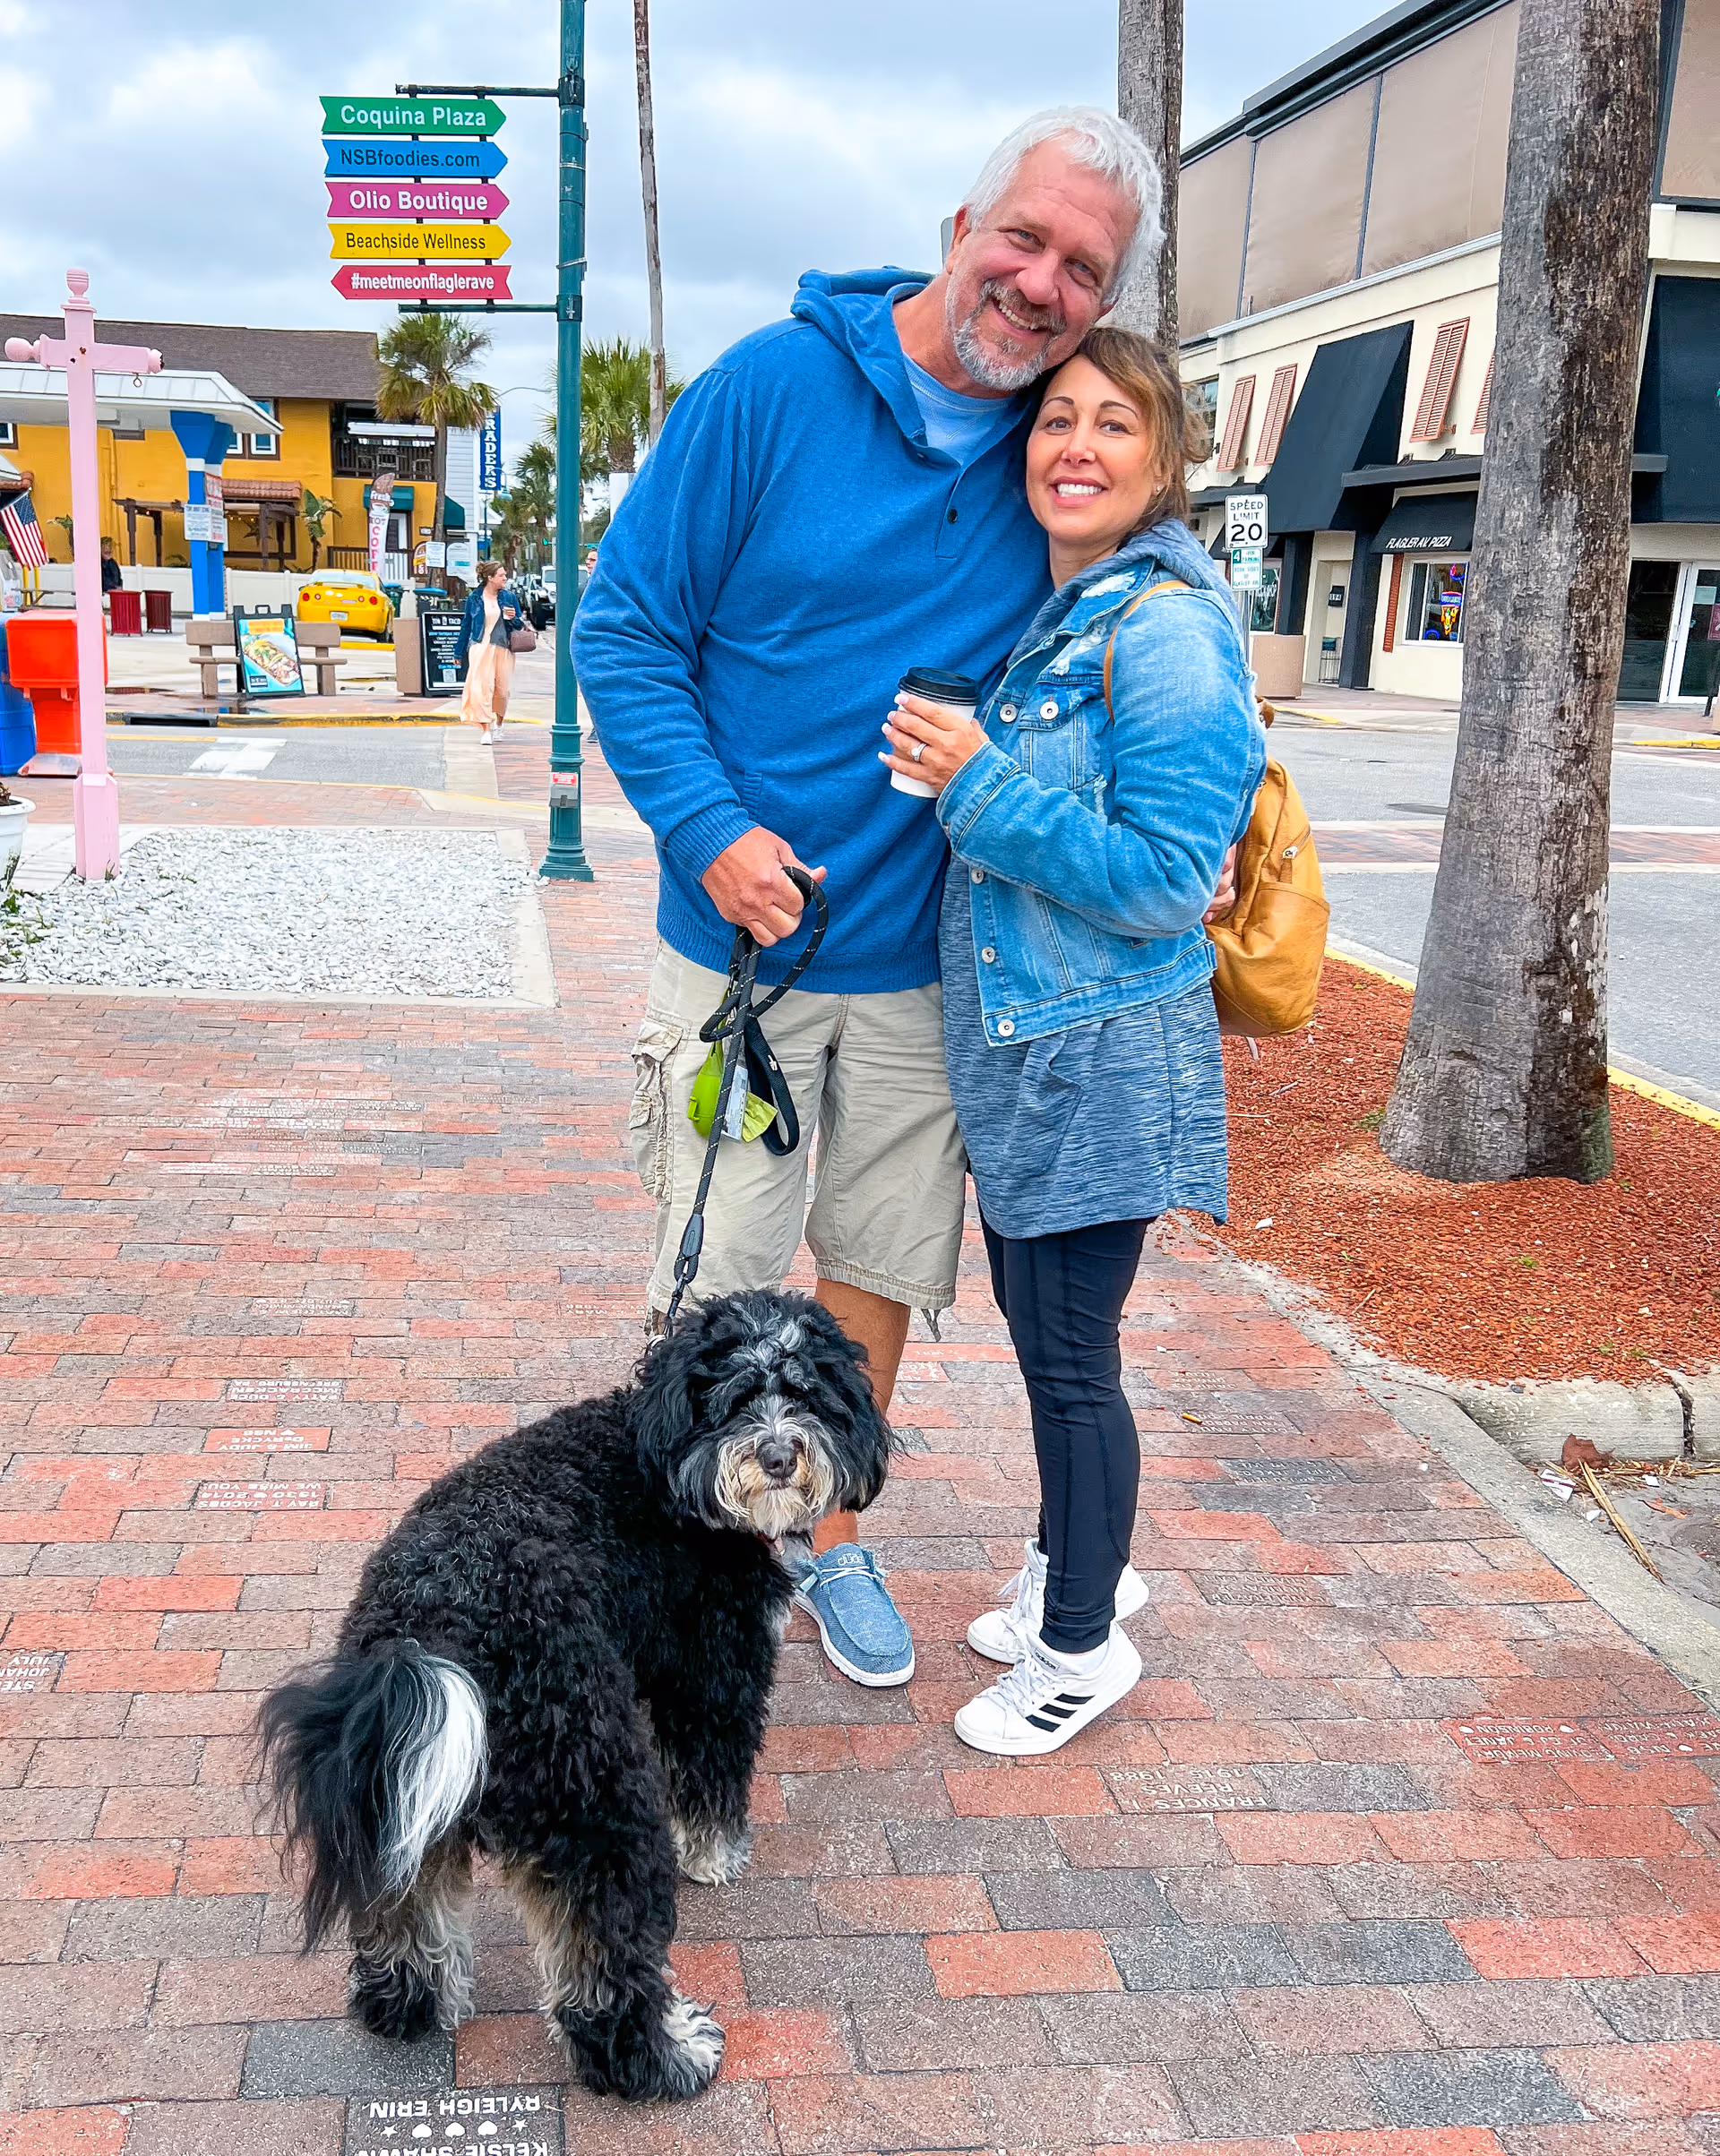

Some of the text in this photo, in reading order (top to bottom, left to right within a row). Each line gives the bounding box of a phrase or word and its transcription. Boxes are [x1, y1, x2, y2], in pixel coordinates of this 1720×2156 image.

[340, 105, 486, 129] Coquina Plaza
[340, 149, 480, 167] NSBfoodies.com
[349, 190, 488, 215] Olio Boutique
[346, 232, 486, 249] Beachside Wellness
[350, 272, 494, 293] #meetmeonflaglerave
[1230, 502, 1264, 511] SPEED
[1234, 512, 1260, 521] LIMIT
[1231, 523, 1262, 542] 20
[1386, 537, 1420, 548] FLAGLER
[1428, 537, 1452, 547] PIZZA
[1234, 549, 1241, 563] 4
[197, 1500, 262, 1508] JACOBS
[1035, 1652, 1056, 1670] adidas
[0, 1680, 36, 1691] STE
[1475, 1723, 1554, 1735] ROBINSON
[1465, 1735, 1515, 1746] JANET
[1472, 1748, 1544, 1759] MEMORY
[1626, 1745, 1672, 1755] NSB
[1189, 1768, 1245, 1778] 1915
[1140, 1782, 1234, 1794] REEVES
[1154, 1796, 1268, 1810] FRANCES
[369, 2095, 541, 2119] RYLEIGH ERIN
[465, 2141, 548, 2156] KELSIE
